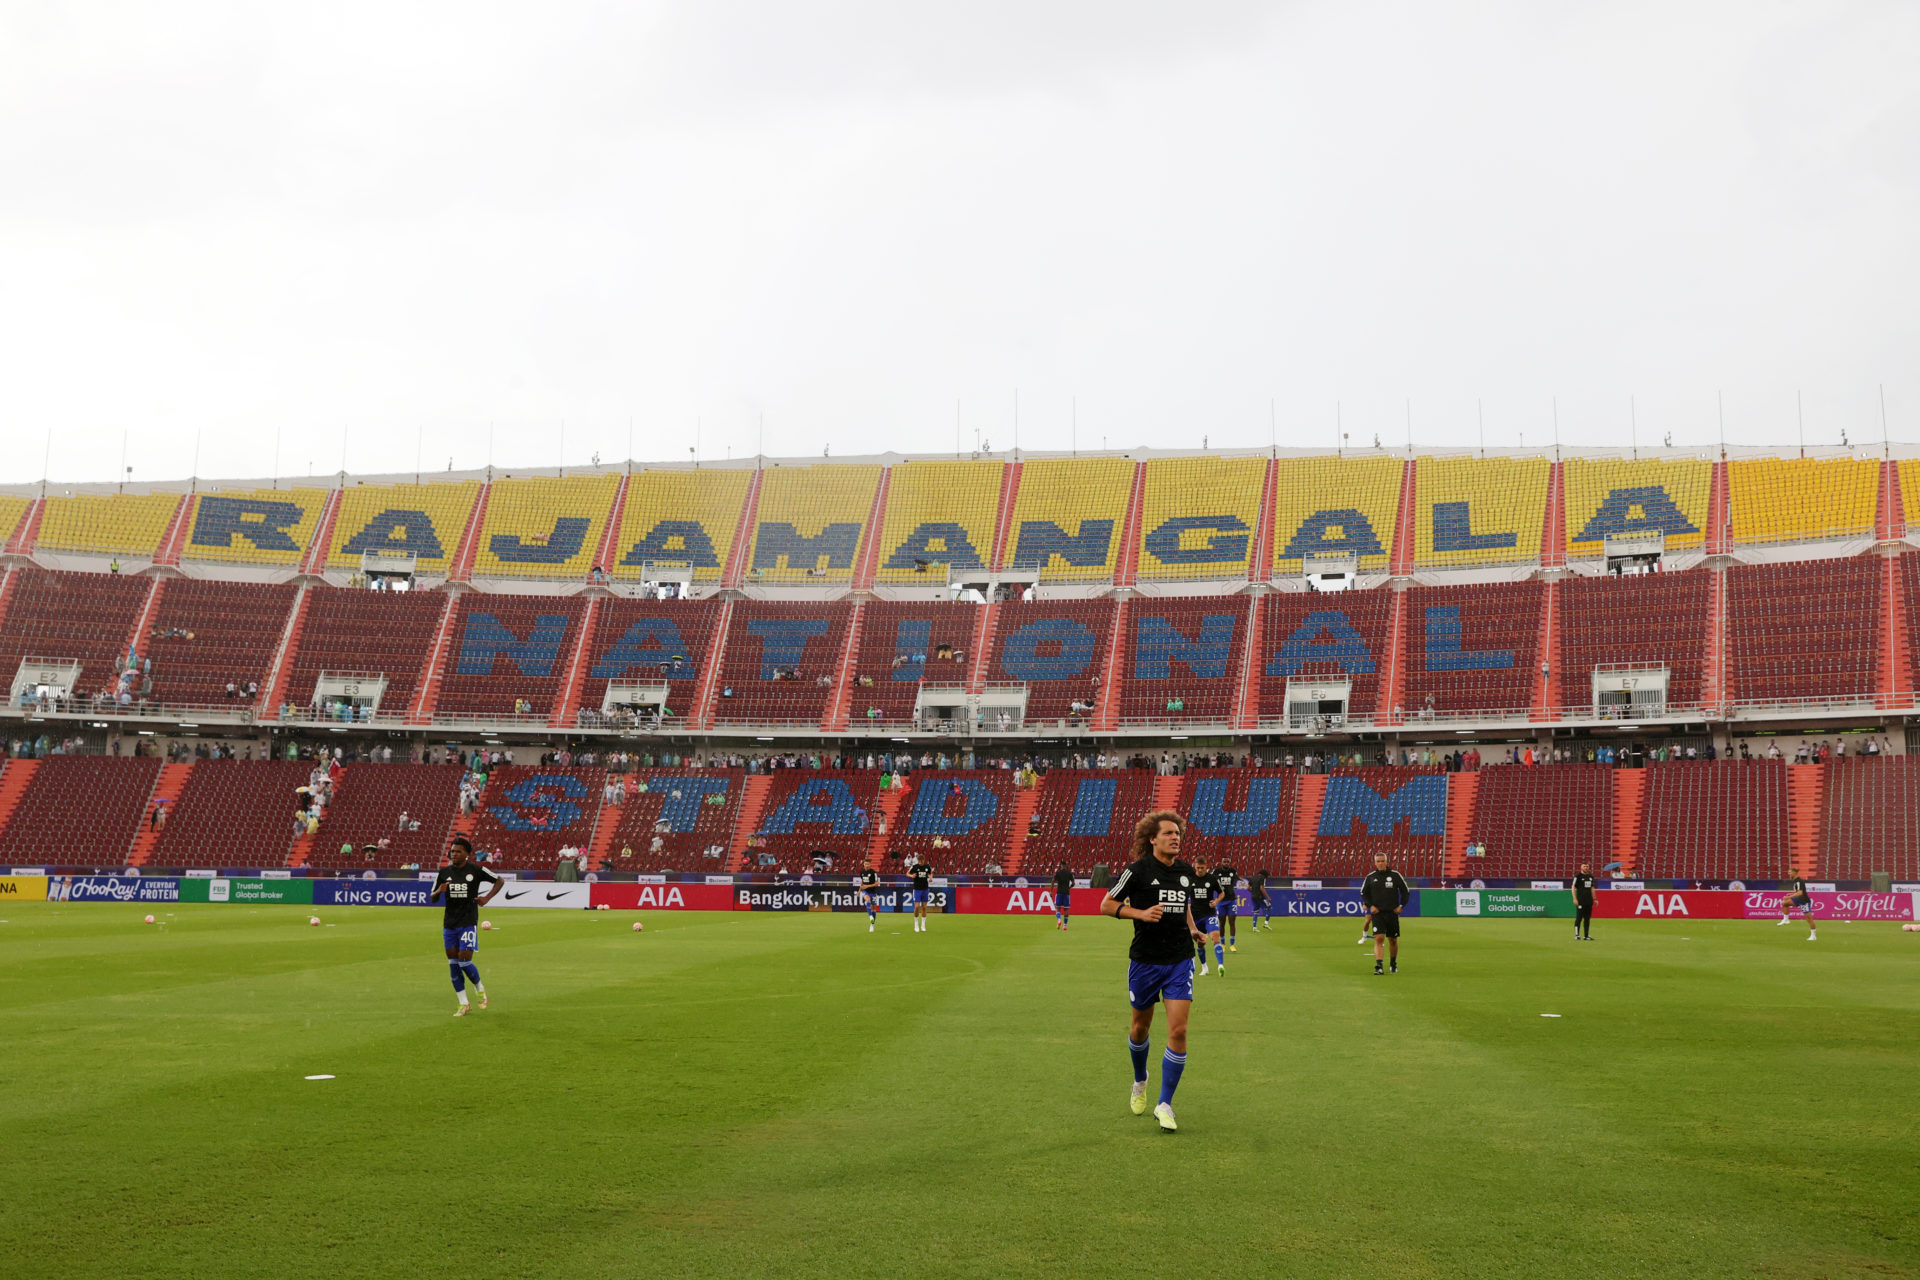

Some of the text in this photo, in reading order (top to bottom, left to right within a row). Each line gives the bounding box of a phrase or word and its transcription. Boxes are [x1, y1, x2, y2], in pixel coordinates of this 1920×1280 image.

[40, 672, 58, 683] E2
[1622, 678, 1639, 689] E7
[344, 685, 360, 695] E3
[631, 692, 646, 702] E4
[72, 878, 141, 901] HooRay!
[145, 881, 176, 889] EVERYDAY
[237, 882, 263, 890] Trusted
[449, 883, 468, 891] FBS
[140, 889, 179, 900] PROTEIN
[235, 891, 284, 899] Global Broker
[334, 890, 427, 904] KING POWER
[637, 886, 685, 907] AIA
[740, 890, 819, 909] Bangkok,
[1158, 889, 1186, 902] FBS
[1487, 894, 1520, 902] Trusted
[1006, 890, 1057, 911] AIA
[1635, 893, 1689, 915] AIA
[1834, 893, 1896, 918] Soffell
[1288, 901, 1331, 914] KING
[1487, 904, 1545, 912] Global Broker
[460, 930, 476, 944] 40
